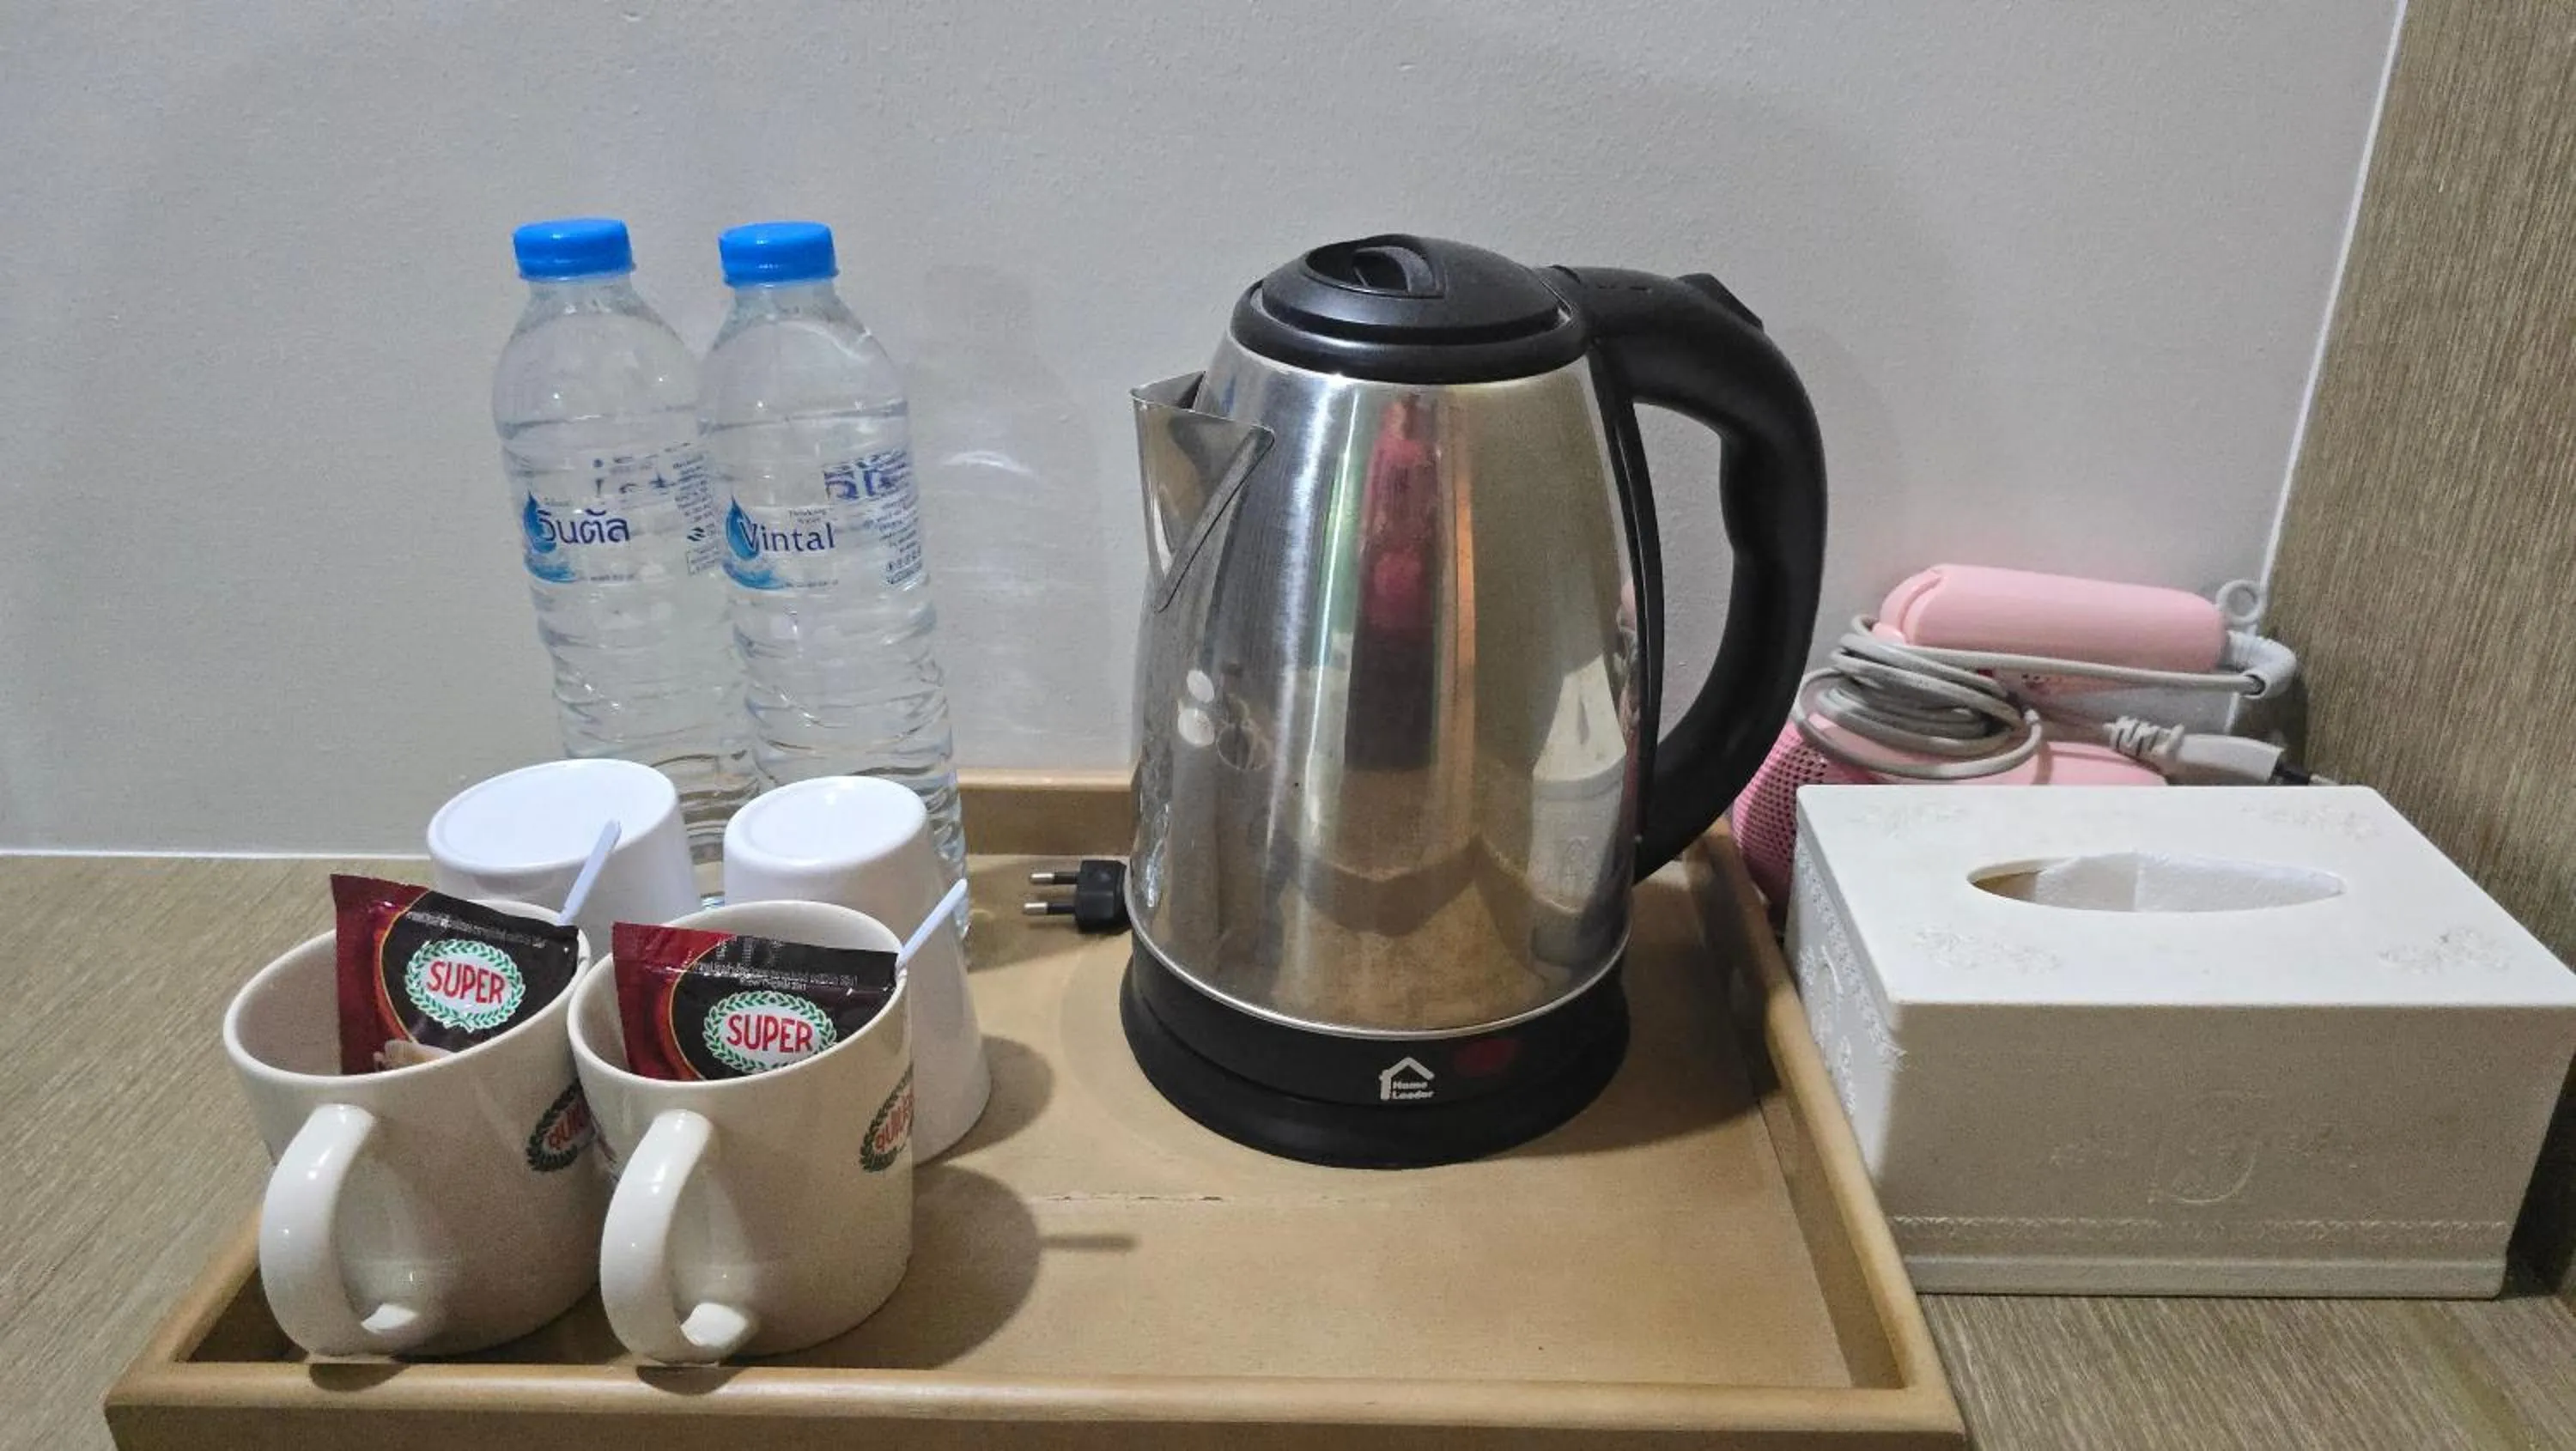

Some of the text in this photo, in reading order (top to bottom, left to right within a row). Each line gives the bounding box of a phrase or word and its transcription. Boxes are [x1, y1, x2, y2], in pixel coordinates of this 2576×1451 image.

[739, 521, 835, 552] Vintal
[426, 960, 507, 1005] SUPER
[726, 1015, 814, 1053] SUPER
